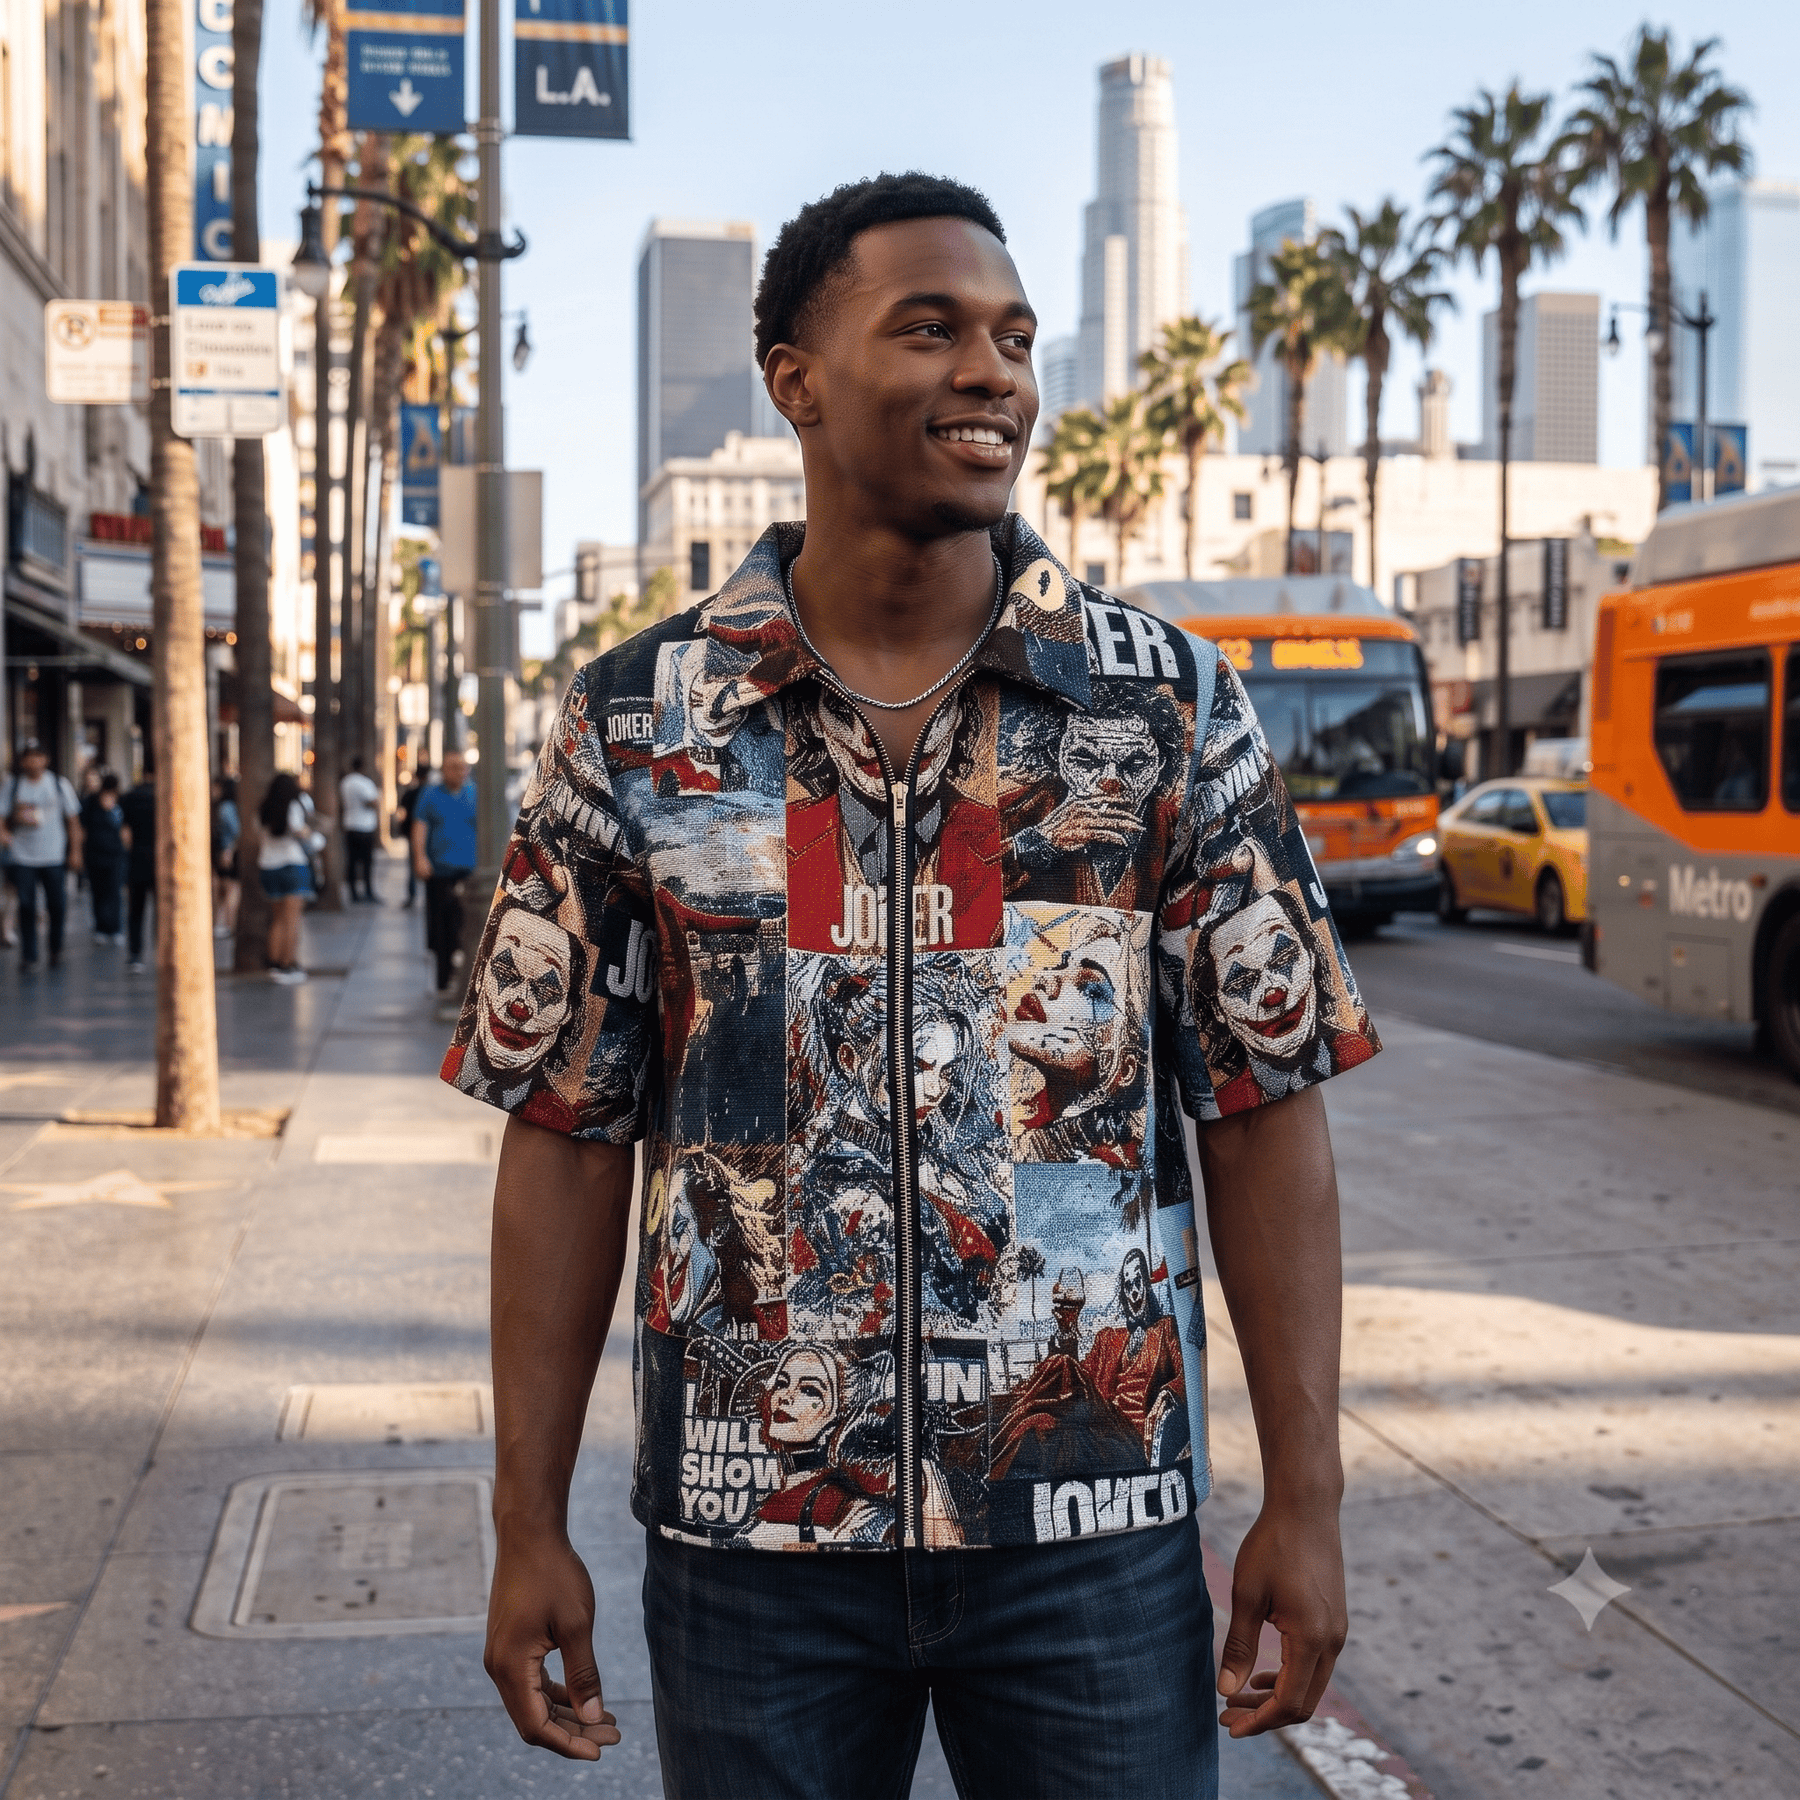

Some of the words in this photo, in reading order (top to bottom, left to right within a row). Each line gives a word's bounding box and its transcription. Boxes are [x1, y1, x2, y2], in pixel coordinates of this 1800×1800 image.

[536, 64, 611, 107] L.A.
[1085, 600, 1180, 679] ER
[605, 712, 653, 744] JOKER
[1668, 863, 1753, 923] Metro
[685, 1383, 696, 1416] I
[921, 1362, 982, 1403] IN
[684, 1417, 768, 1454] WILL
[680, 1486, 750, 1523] YOU
